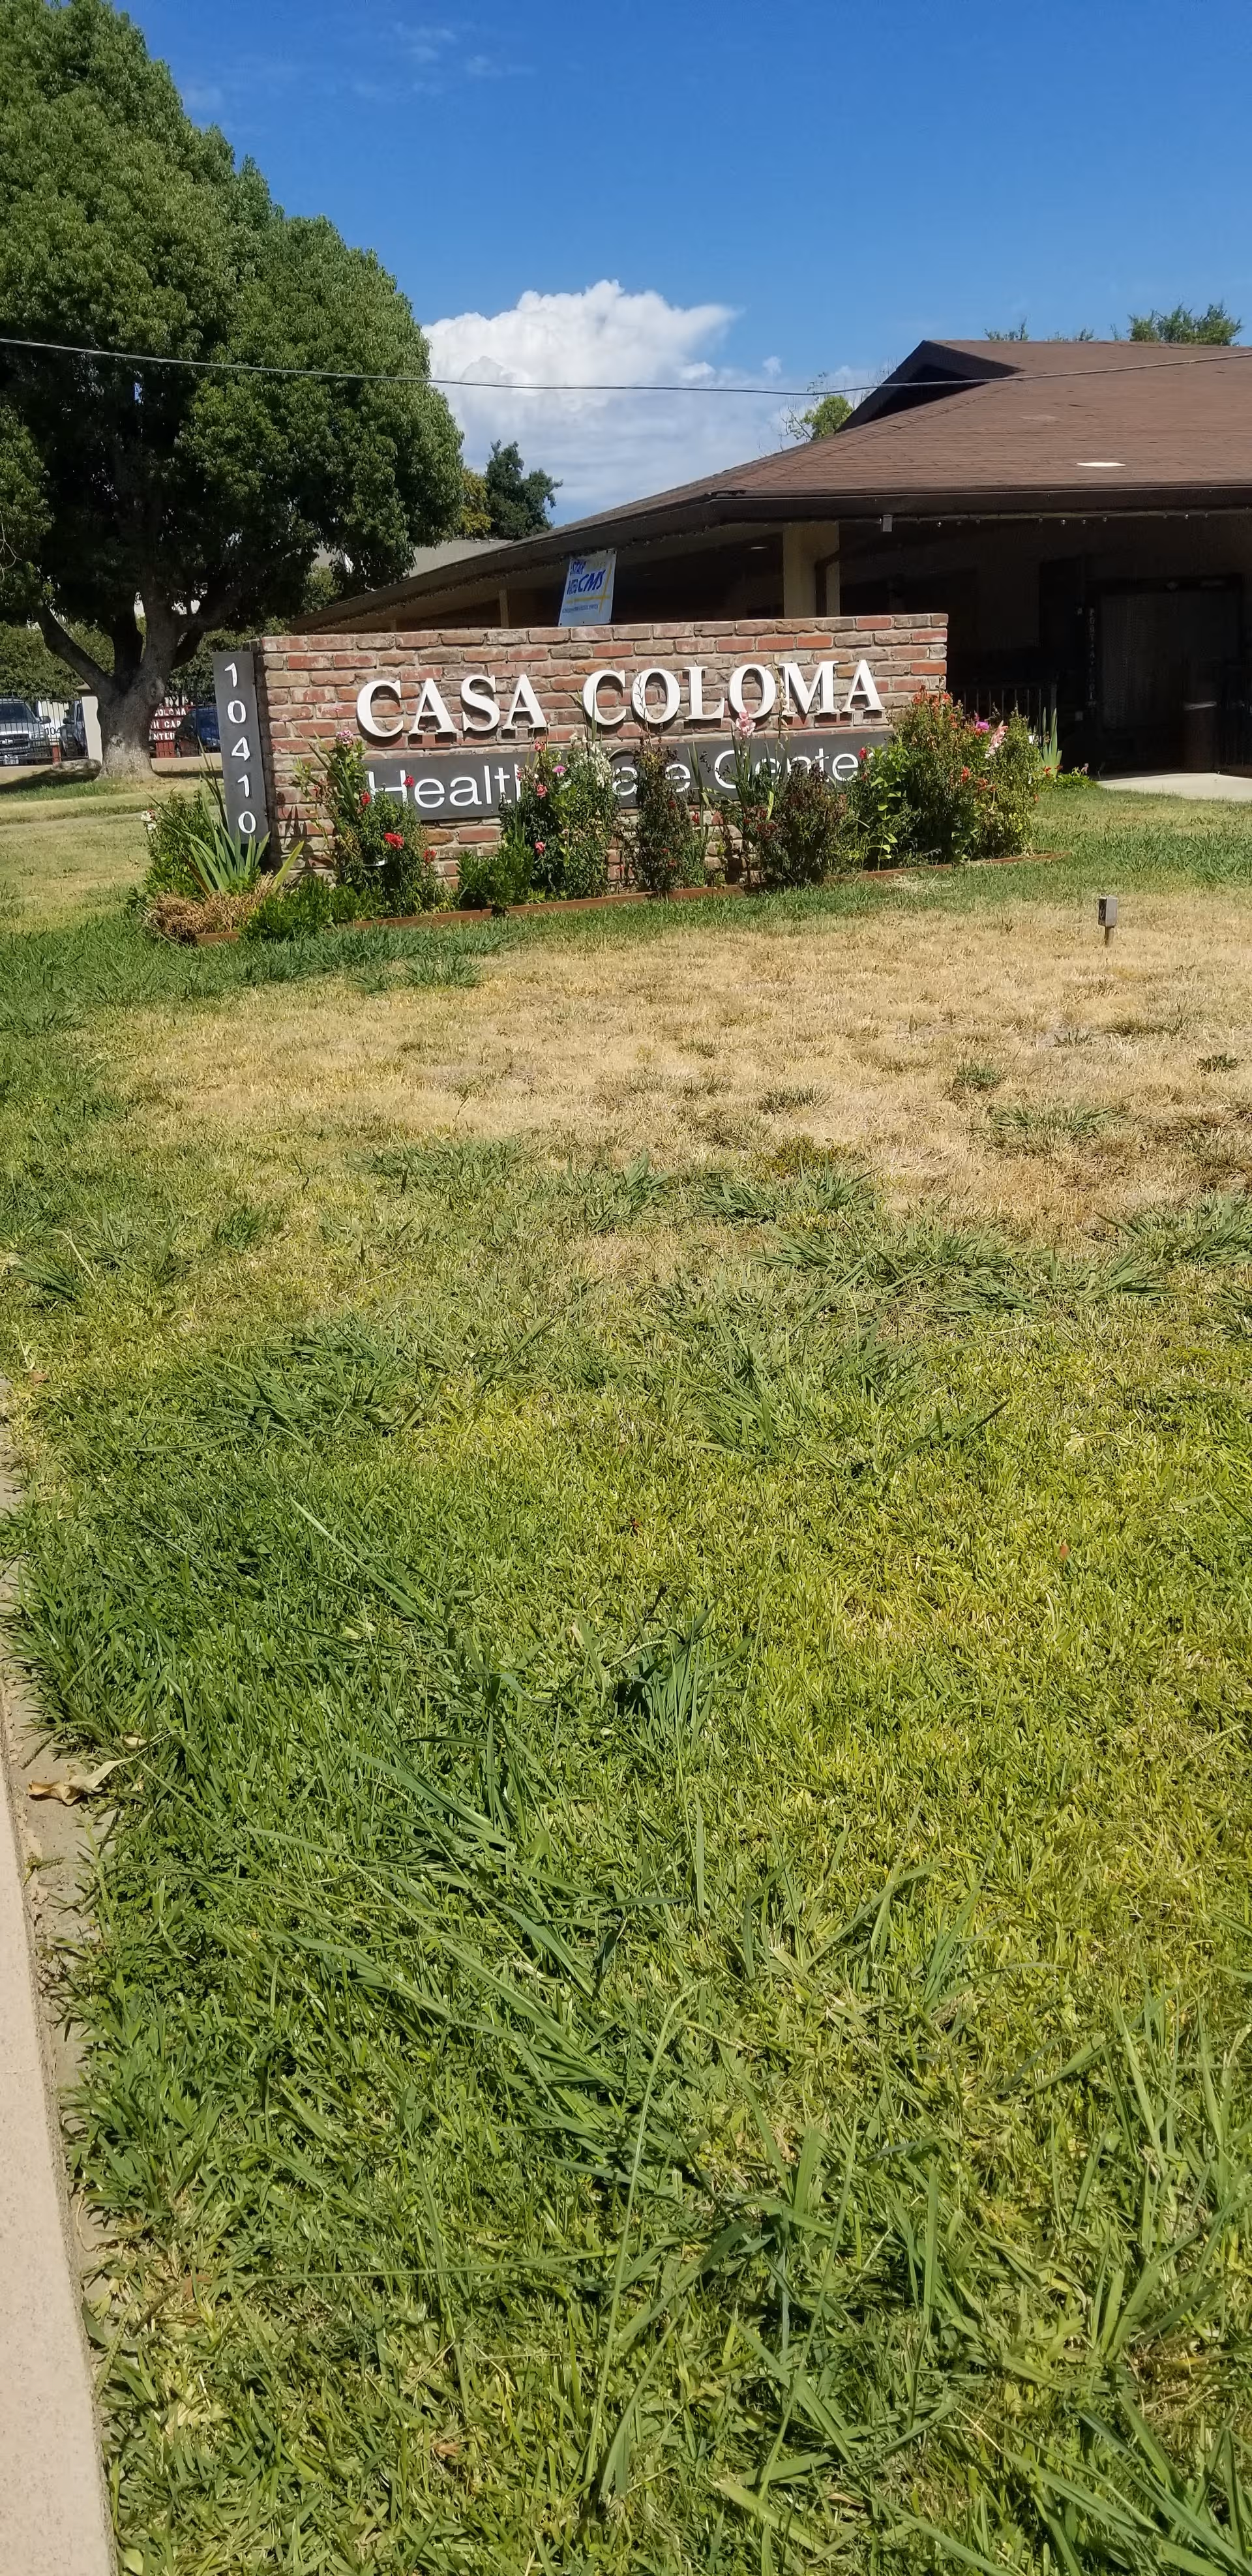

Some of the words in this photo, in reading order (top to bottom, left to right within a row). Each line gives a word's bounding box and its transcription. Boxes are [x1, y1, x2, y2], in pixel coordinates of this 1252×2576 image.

[578, 569, 606, 593] CMS
[357, 674, 548, 738] CASA
[582, 659, 885, 726] COLOMA
[224, 662, 256, 834] 10410
[714, 748, 862, 790] Cente
